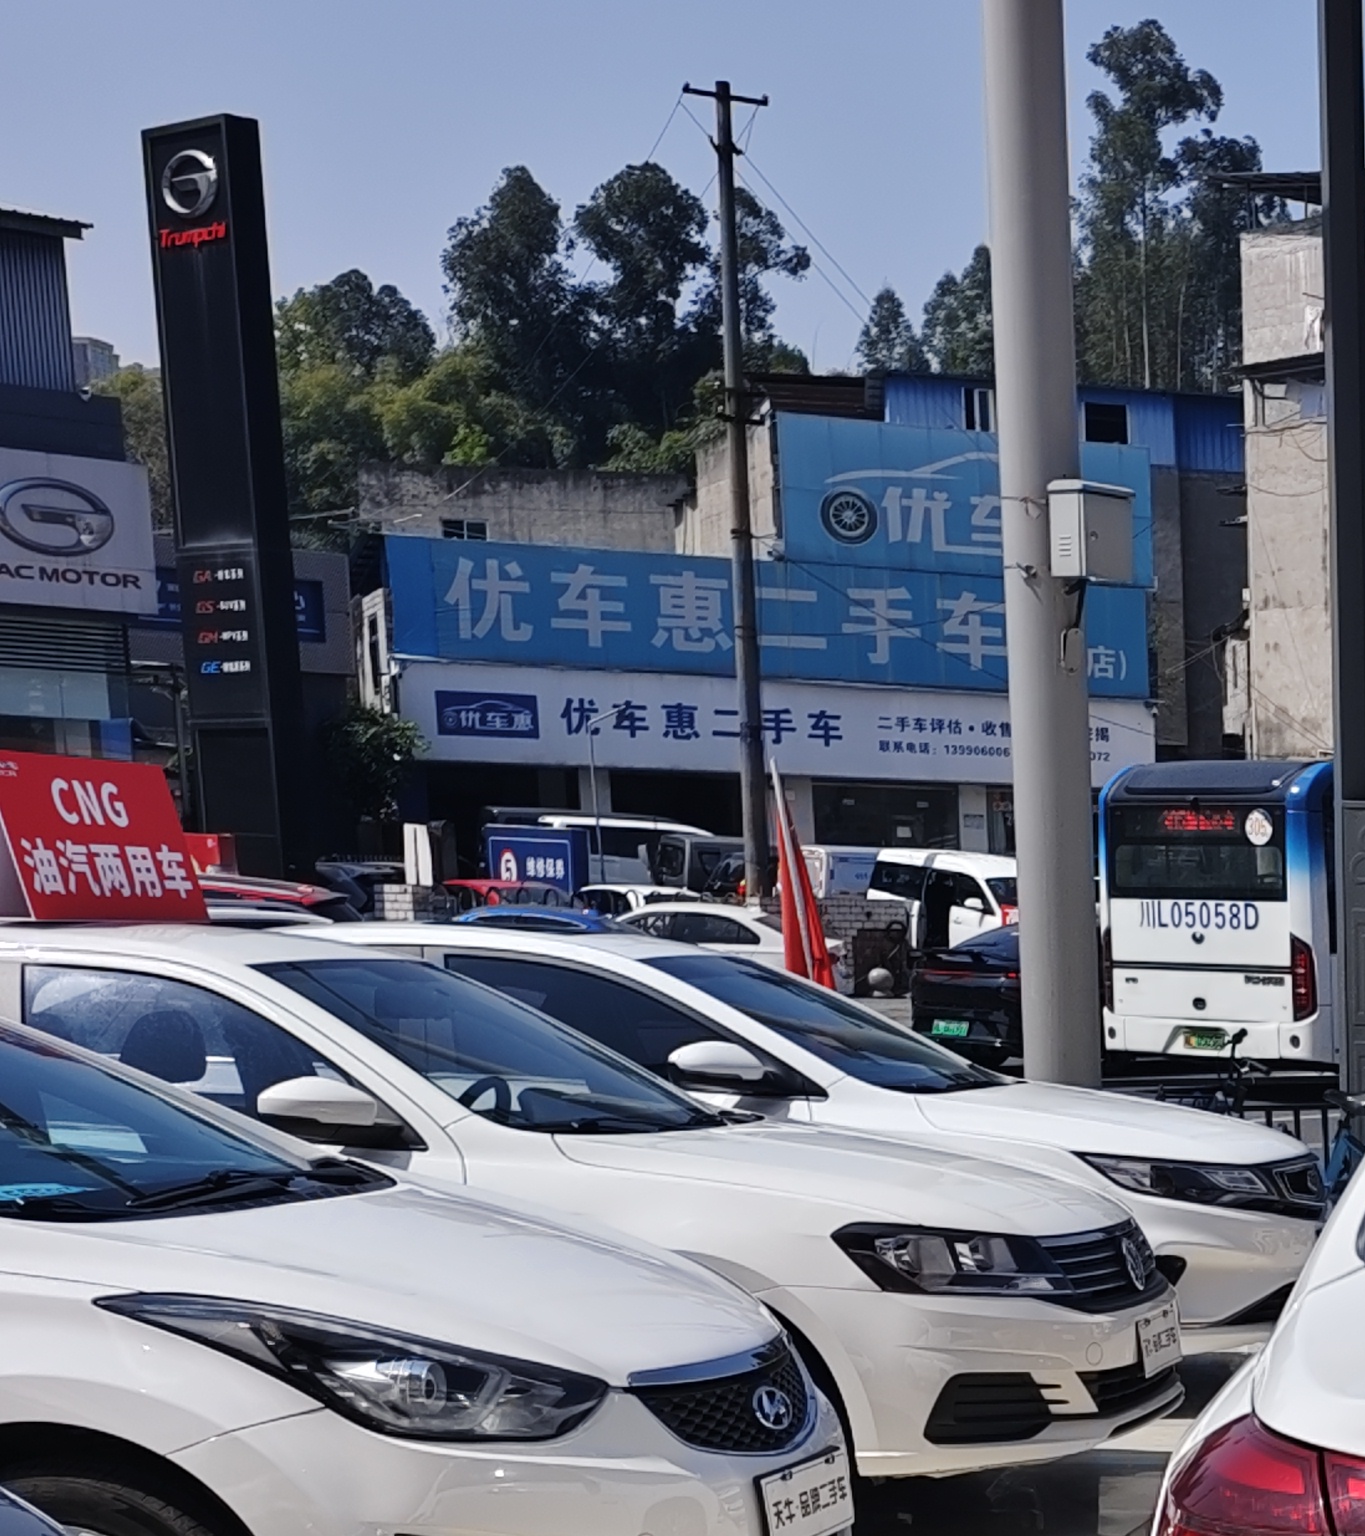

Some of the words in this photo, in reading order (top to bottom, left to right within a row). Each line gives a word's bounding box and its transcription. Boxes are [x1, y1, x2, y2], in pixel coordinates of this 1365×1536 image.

[159, 221, 226, 248] Trumpchi
[38, 566, 142, 590] MOTOR
[445, 557, 1007, 670] 优车惠二手车
[560, 697, 843, 748] 优车惠二手车
[50, 777, 129, 828] CNG
[21, 837, 193, 899] 油汽两用车
[1139, 900, 1260, 930] 川L05058D
